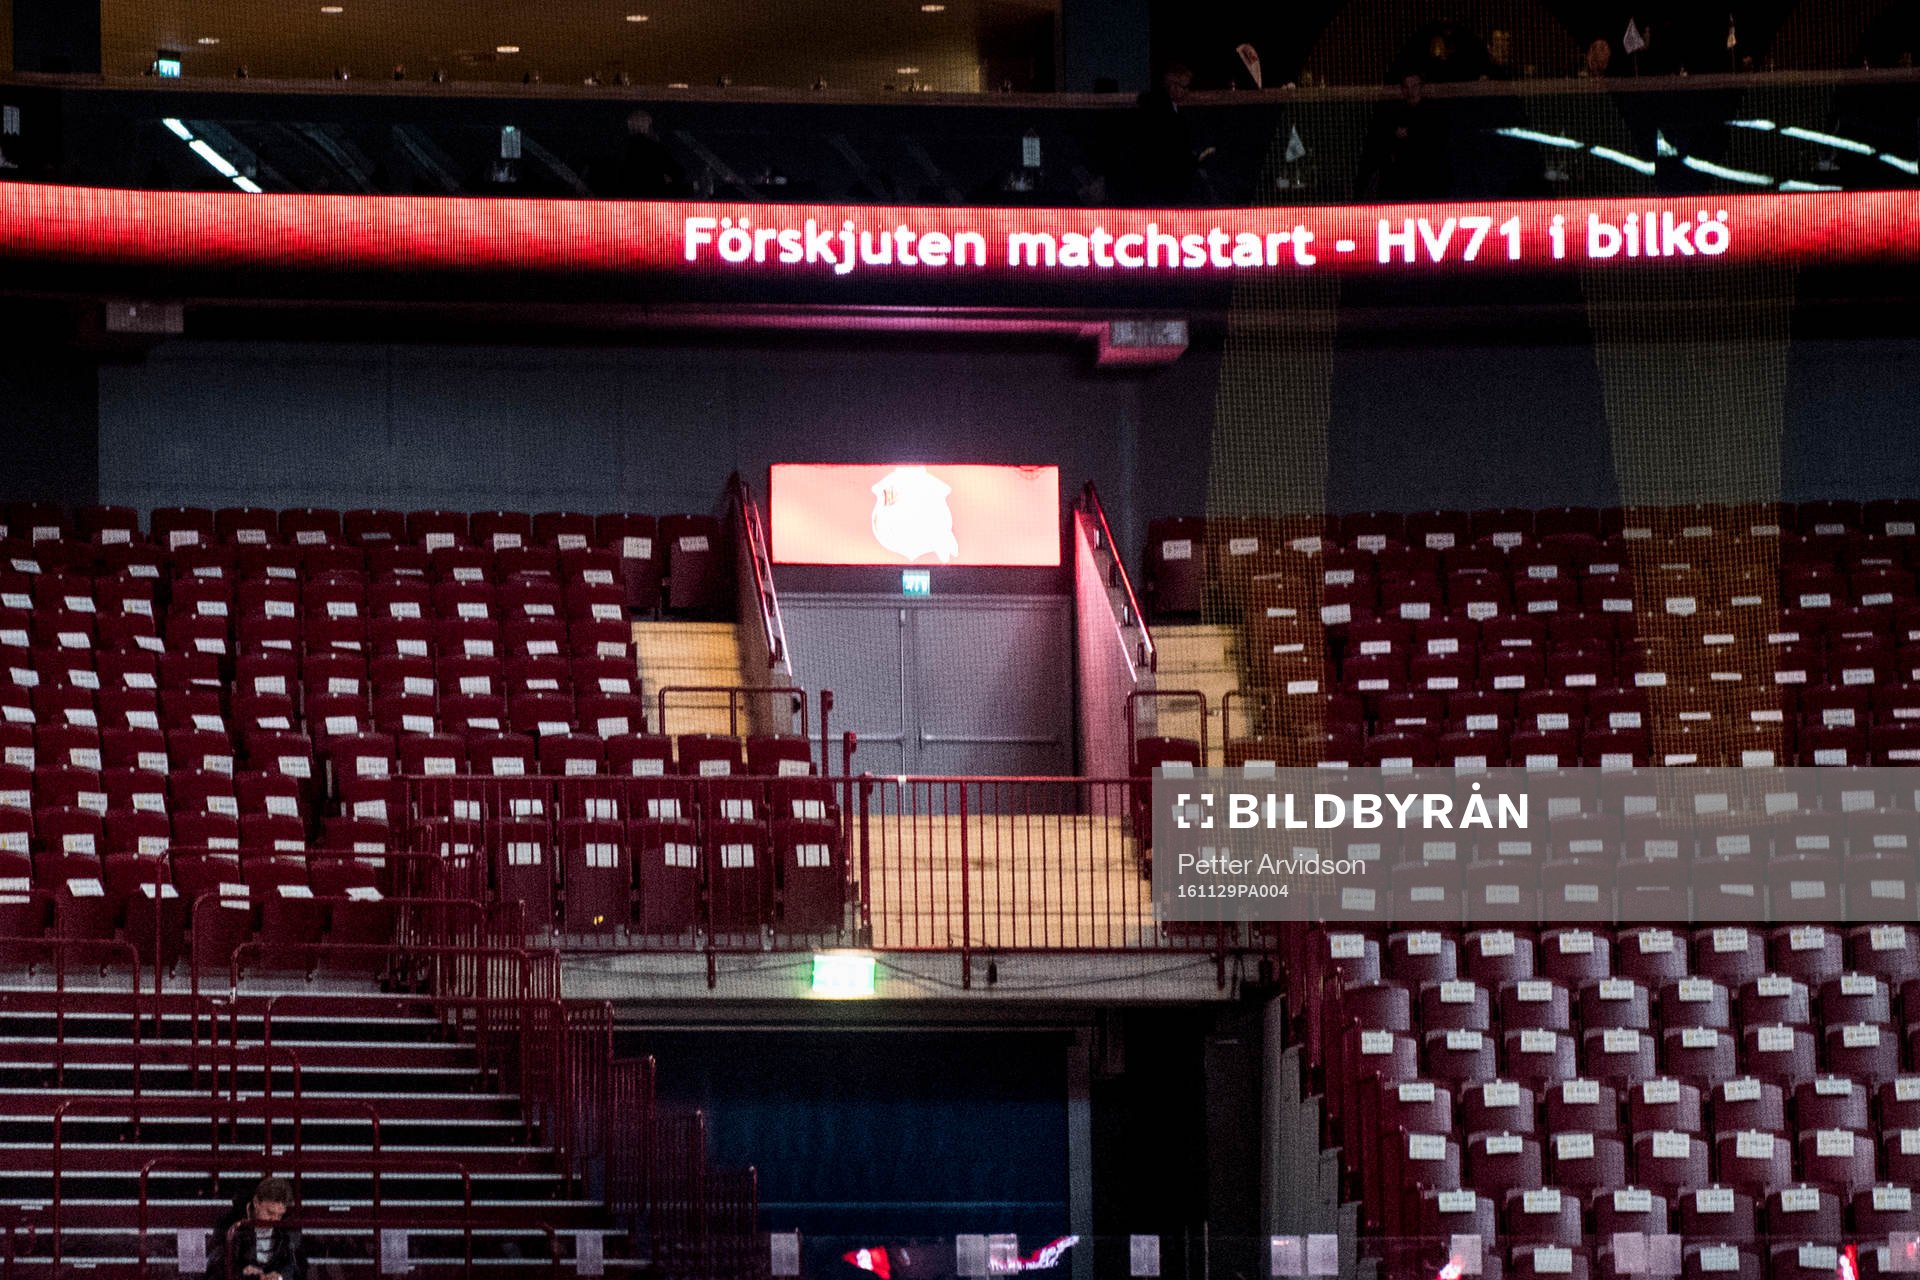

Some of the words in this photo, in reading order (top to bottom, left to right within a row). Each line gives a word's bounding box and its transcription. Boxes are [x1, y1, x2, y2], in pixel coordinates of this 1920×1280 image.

[684, 217, 987, 275] Förskjuten
[1008, 222, 1316, 268] matchstart
[1335, 239, 1356, 252] -
[1378, 215, 1521, 263] HV71
[1549, 213, 1566, 259] i
[1587, 209, 1730, 258] bilkö
